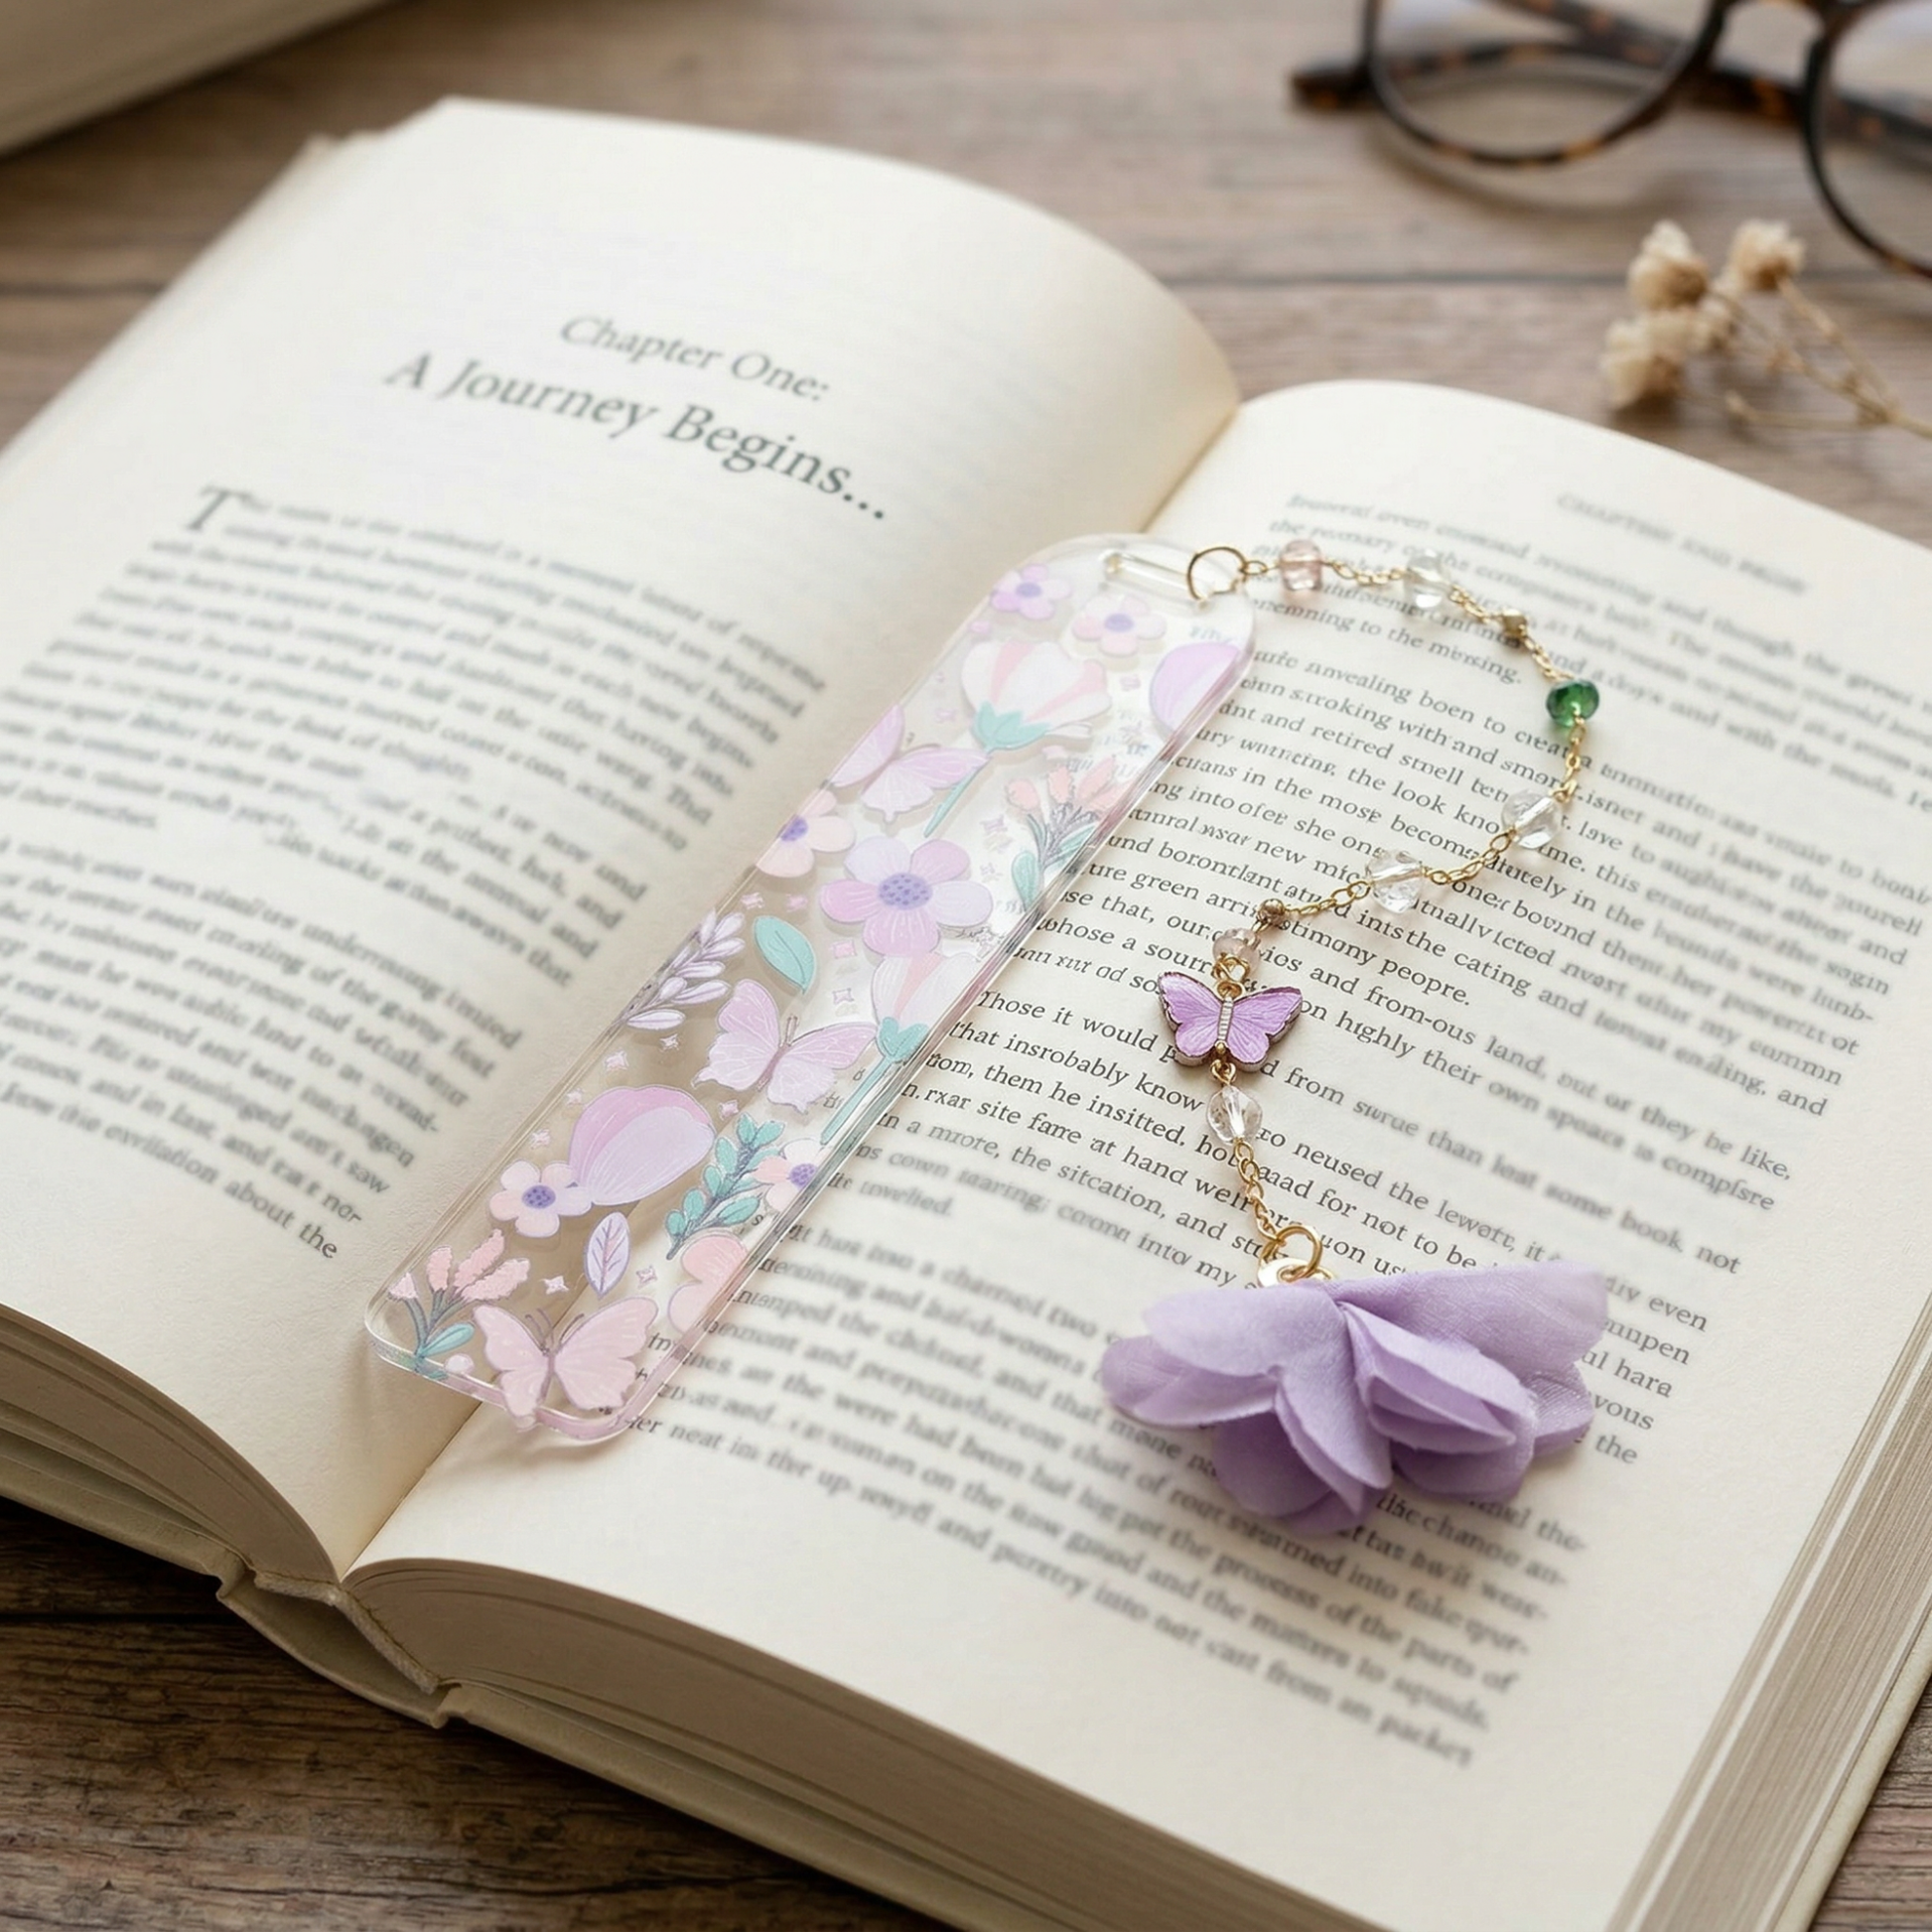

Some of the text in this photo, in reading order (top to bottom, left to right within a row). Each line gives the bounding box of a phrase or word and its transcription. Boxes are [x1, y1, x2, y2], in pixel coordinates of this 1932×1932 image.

[560, 315, 830, 401] Chapter One:
[384, 352, 885, 520] A Journey Begins...
[1359, 621, 1424, 647] to the
[1399, 721, 1447, 746] with
[1419, 690, 1474, 723] boen
[1483, 717, 1505, 734] to
[1189, 786, 1234, 809] into
[1295, 818, 1335, 841] she
[1243, 767, 1266, 785] in
[1275, 778, 1312, 799] the
[1573, 891, 1595, 911] in
[1605, 904, 1644, 931] the
[1255, 841, 1306, 864] new
[1311, 727, 1394, 759] retired
[1859, 939, 1907, 965] and
[1348, 768, 1386, 790] the
[1392, 781, 1446, 814] look
[1454, 804, 1504, 839] kno
[1596, 865, 1640, 893] this
[1131, 874, 1198, 899] green
[1102, 897, 1154, 923] that,
[1311, 968, 1359, 995] and
[1365, 986, 1474, 1044] from-ous
[1740, 1145, 1790, 1180] like,
[1122, 938, 1136, 950] a
[1338, 1011, 1415, 1057] highly
[1423, 1049, 1481, 1084] their
[1406, 930, 1446, 957] the
[1454, 953, 1531, 997] cating
[1538, 990, 1587, 1018] and
[1778, 1090, 1828, 1116] and
[347, 1163, 388, 1192] saw
[906, 1121, 920, 1134] a
[1012, 1147, 1050, 1172] the
[1176, 1213, 1227, 1240] and
[977, 1101, 1021, 1124] site
[1090, 1138, 1116, 1156] at
[1123, 1146, 1187, 1185] hand
[985, 1065, 1042, 1094] them
[1048, 1081, 1080, 1105] he
[1316, 1188, 1357, 1217] for
[1414, 1234, 1438, 1254] to
[1447, 1245, 1476, 1268] be
[1005, 1035, 1129, 1086] insrobably
[1135, 1072, 1203, 1111] know
[1294, 1144, 1382, 1187] neused
[1389, 1182, 1429, 1209] the
[1649, 1298, 1707, 1331] even
[1052, 1008, 1072, 1026] it
[1084, 1019, 1158, 1051] would
[1285, 1067, 1343, 1105] from
[1697, 1247, 1739, 1274] not
[224, 1182, 337, 1258] about the
[1195, 1261, 1236, 1287] my
[1595, 1435, 1637, 1463] the
